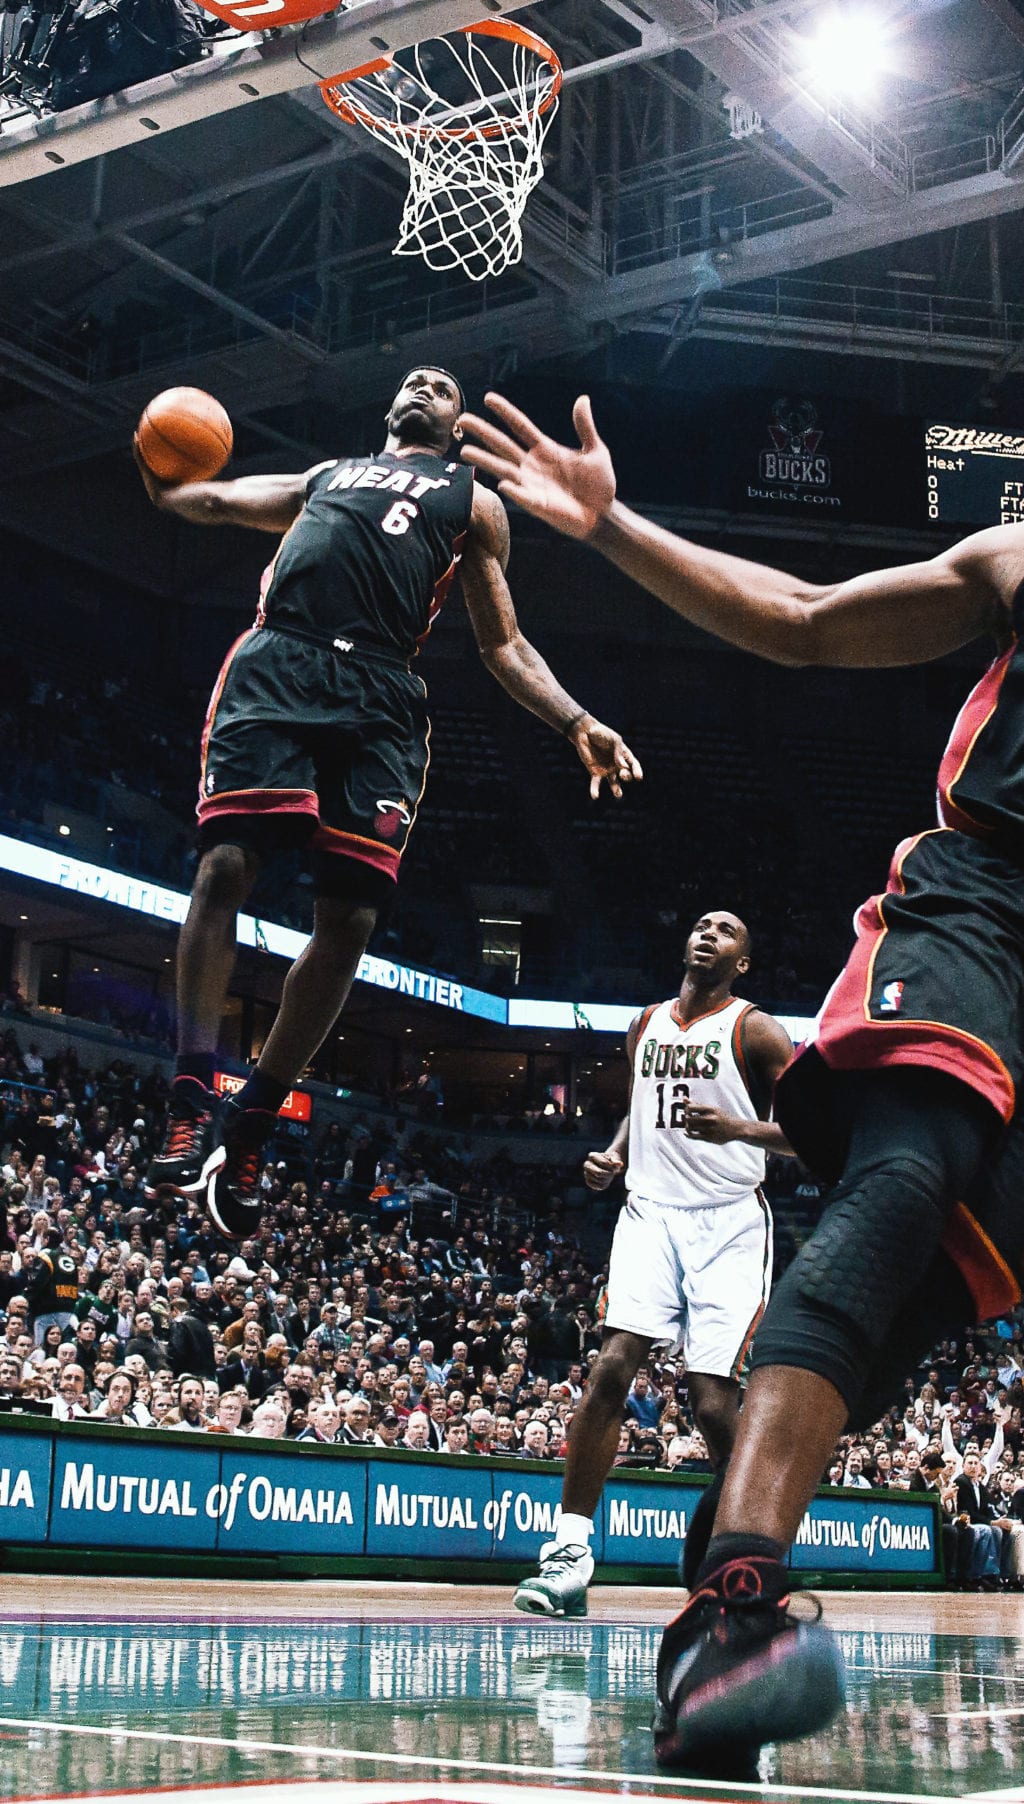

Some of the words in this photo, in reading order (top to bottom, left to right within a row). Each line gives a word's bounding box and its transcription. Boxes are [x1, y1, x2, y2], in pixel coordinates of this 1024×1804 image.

[765, 453, 826, 484] BUCKS
[927, 455, 965, 472] Heat
[327, 465, 451, 500] HEAT
[747, 486, 842, 506] bucks.com
[927, 475, 938, 489] 0
[1004, 482, 1024, 496] FT
[928, 491, 938, 504] 0
[381, 499, 419, 536] 6
[928, 505, 939, 519] 0
[356, 957, 464, 1010] FRONTIER
[641, 1038, 721, 1080] BUCKS
[654, 1083, 691, 1129] 12
[59, 1254, 75, 1272] G
[60, 1462, 197, 1516] MUTUAL
[205, 1472, 247, 1531] of
[249, 1476, 354, 1525] OMAHA
[375, 1483, 478, 1529] MUTUAL
[483, 1490, 513, 1541] of
[609, 1499, 688, 1540] MUTUAL
[795, 1511, 860, 1548] MUTUAL
[861, 1515, 880, 1558] of
[879, 1517, 931, 1551] OMAHA
